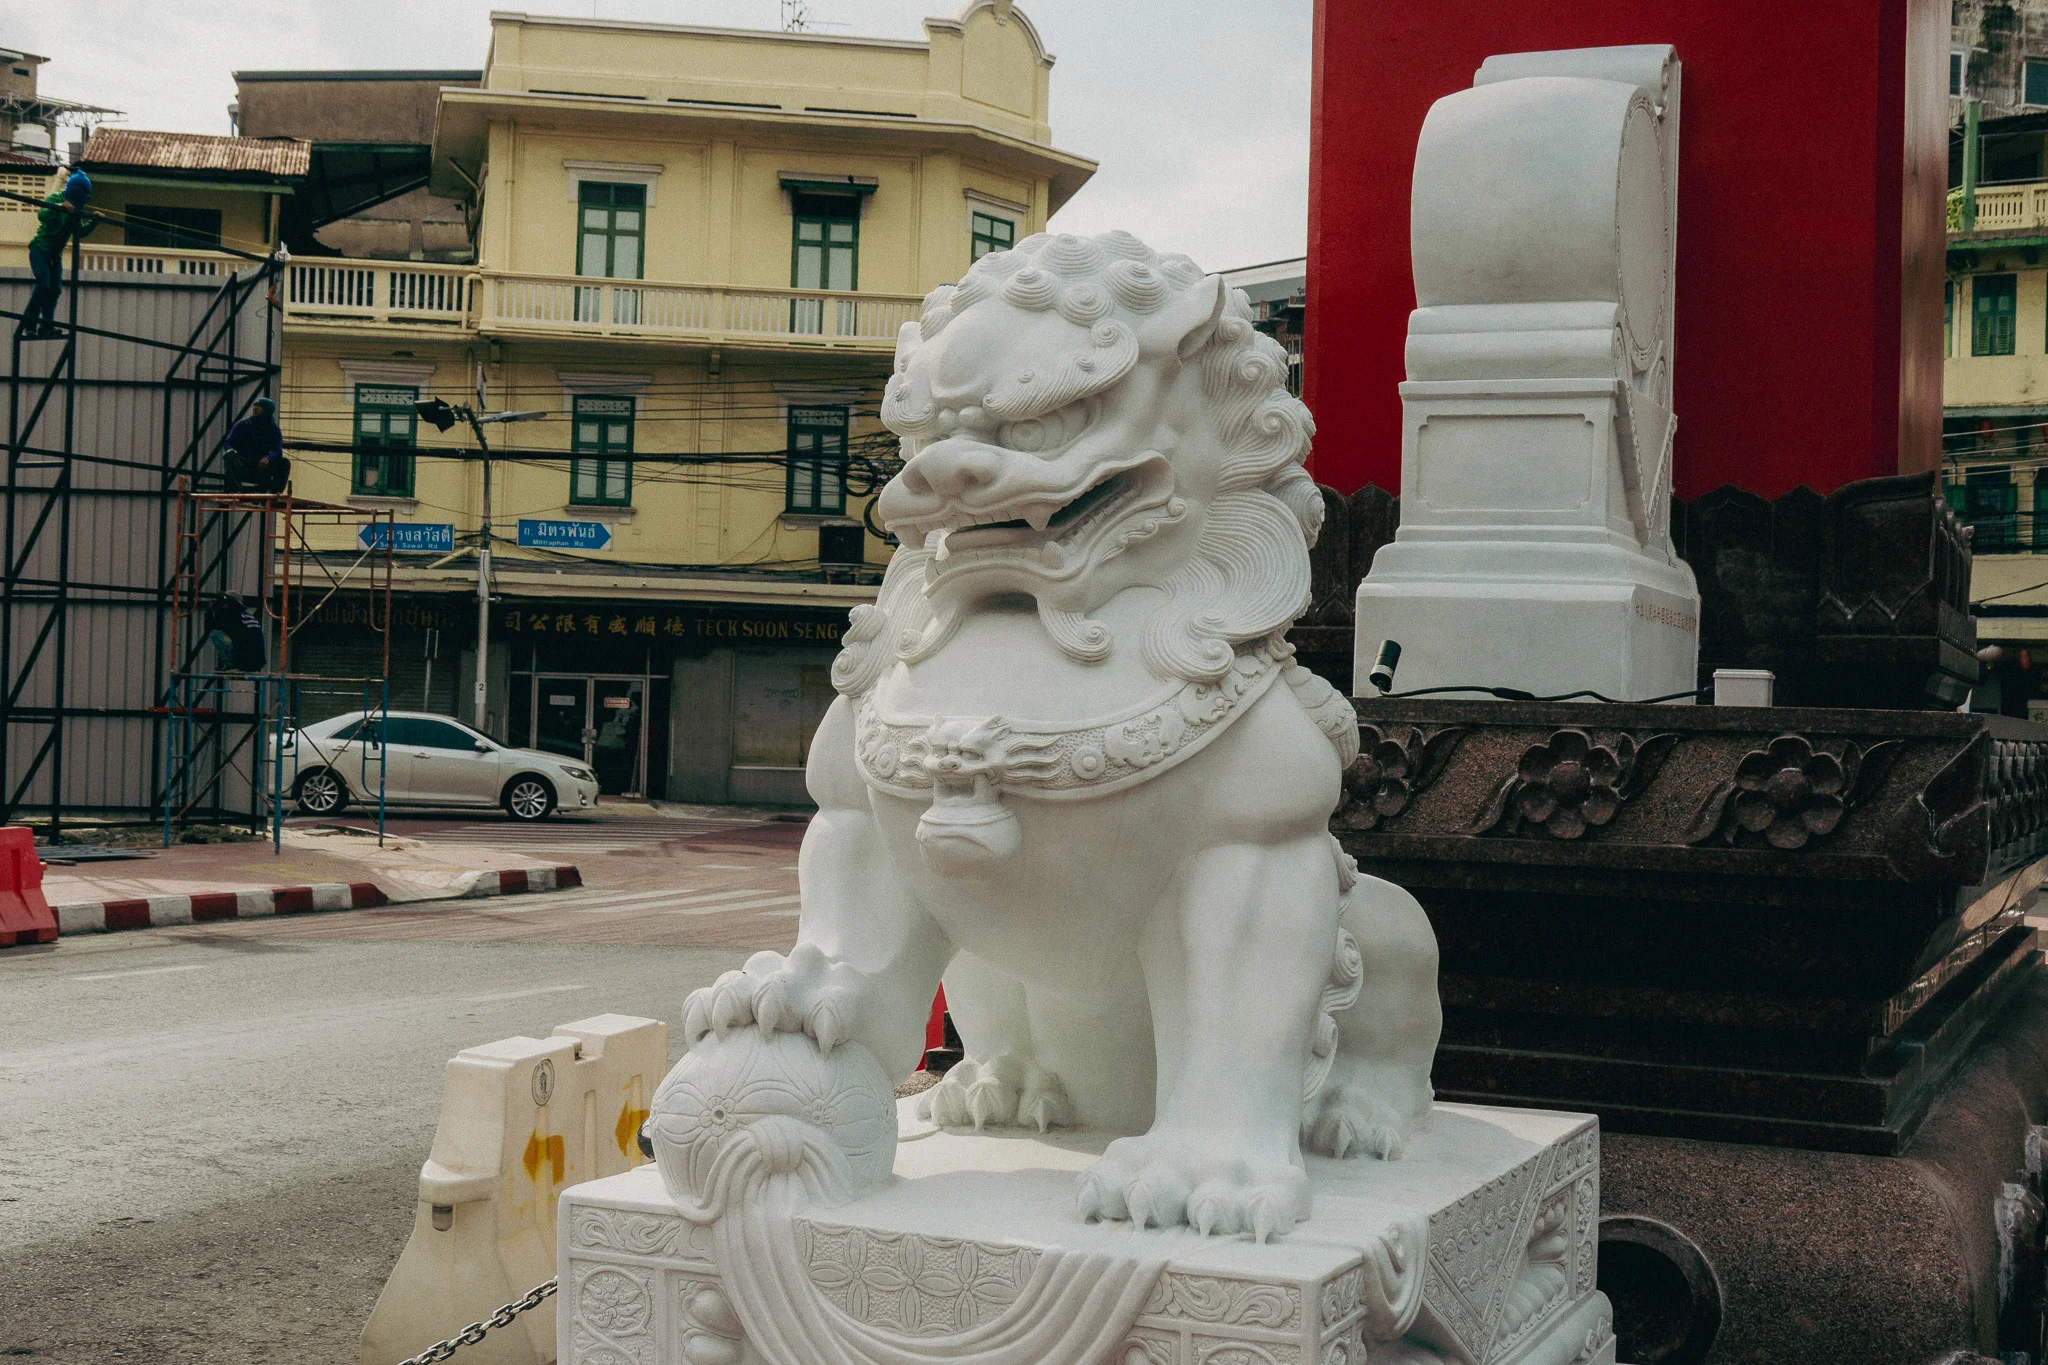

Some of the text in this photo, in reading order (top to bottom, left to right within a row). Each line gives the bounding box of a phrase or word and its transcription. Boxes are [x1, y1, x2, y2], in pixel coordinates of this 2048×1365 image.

[694, 618, 839, 640] TECK SOON SENG
[479, 683, 485, 691] 2
